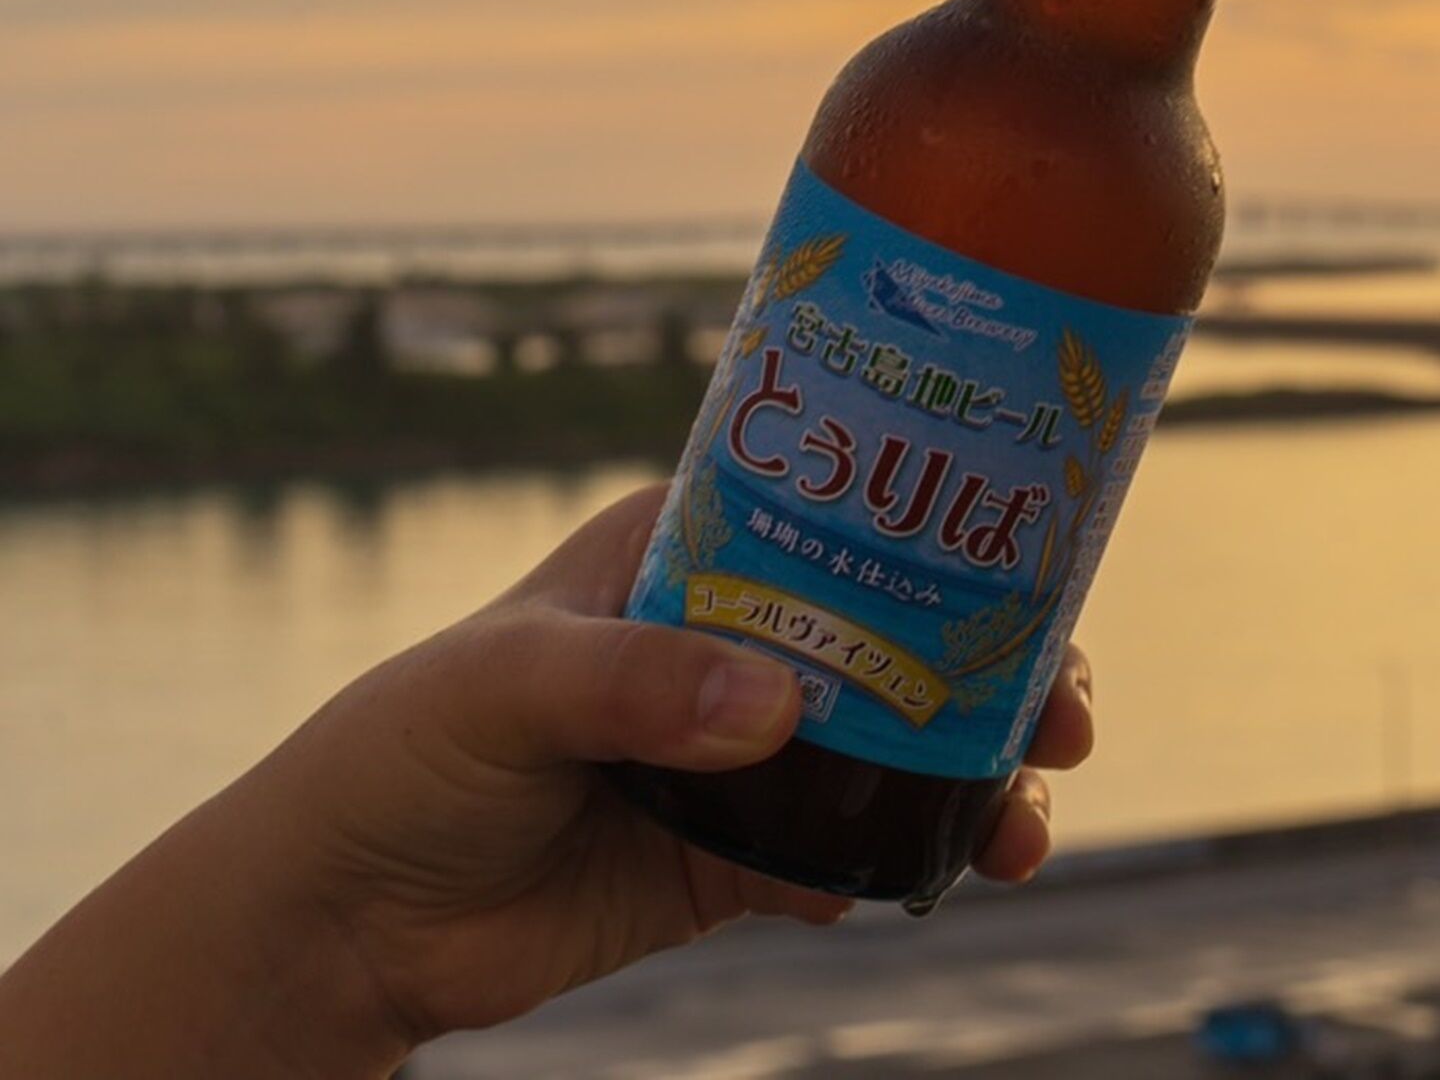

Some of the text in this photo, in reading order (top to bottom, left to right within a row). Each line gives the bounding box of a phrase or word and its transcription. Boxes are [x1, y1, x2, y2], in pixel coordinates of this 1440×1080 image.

[786, 303, 1063, 450] 宮古島地ビール
[747, 507, 943, 608] 珊瑚の水仕込み
[692, 584, 935, 708] コーラルヴァイツェン
